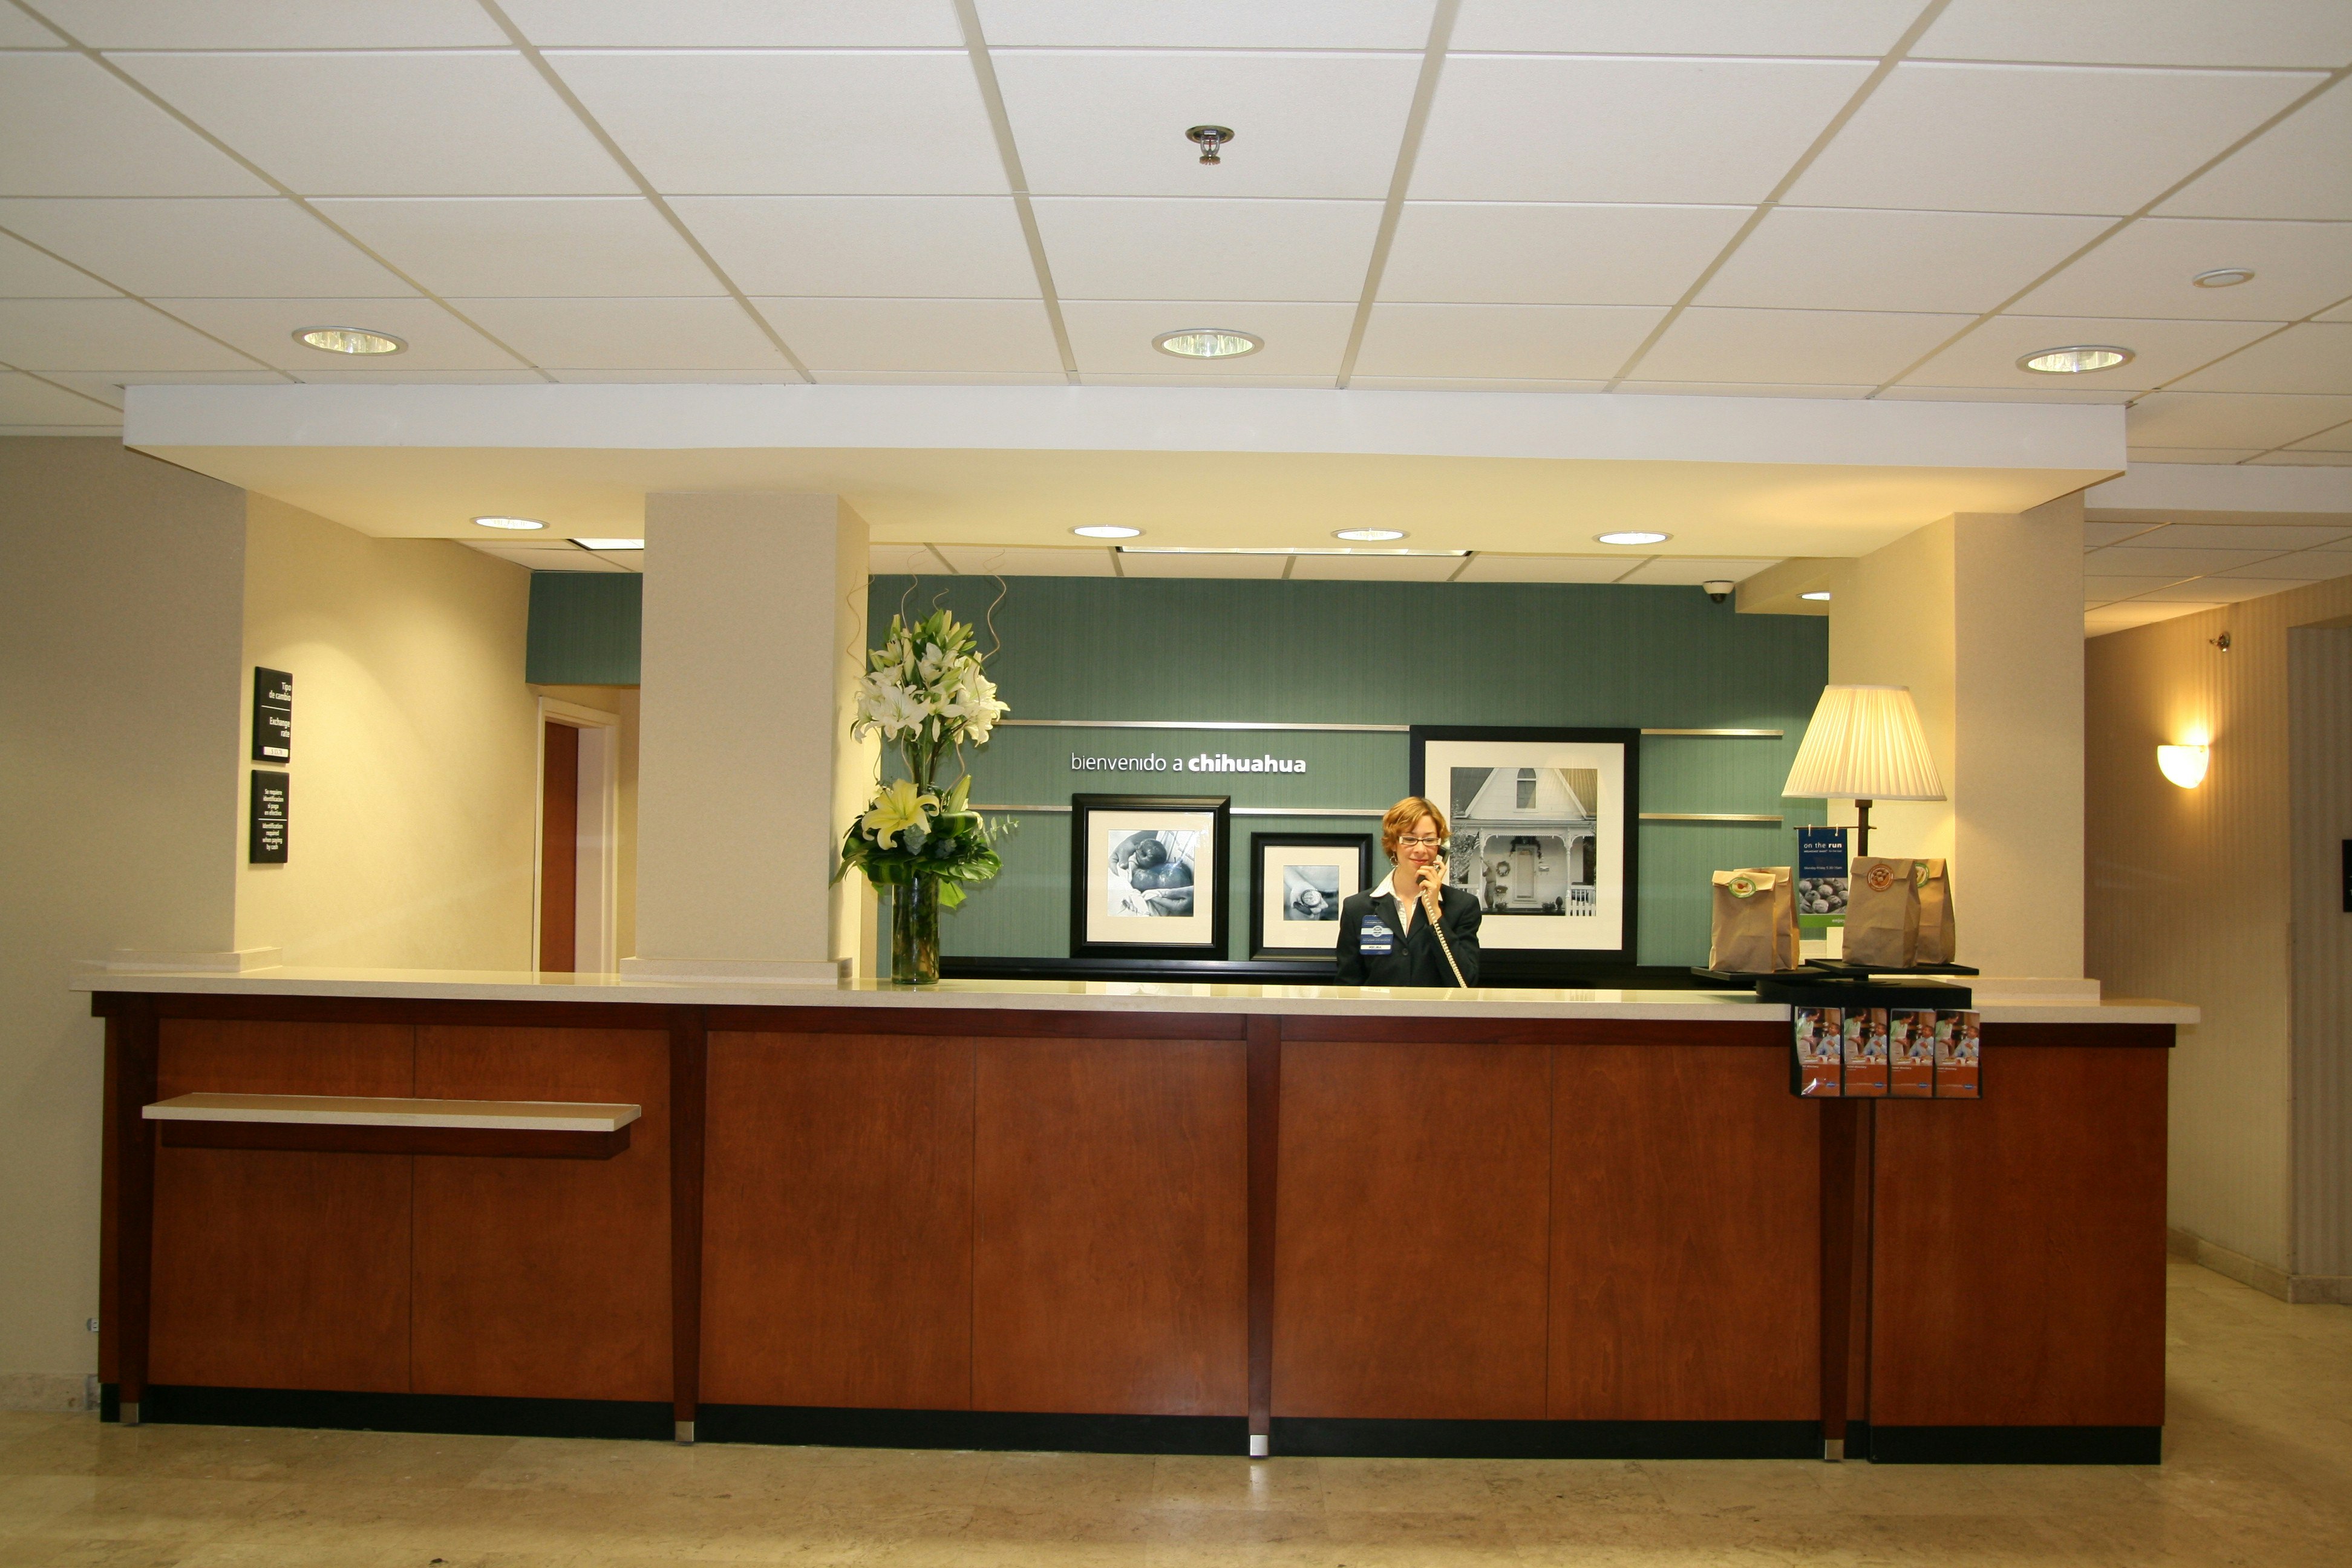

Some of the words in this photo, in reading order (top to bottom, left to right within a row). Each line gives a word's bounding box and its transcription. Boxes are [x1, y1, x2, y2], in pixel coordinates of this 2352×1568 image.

[281, 682, 292, 692] Tipo
[269, 690, 275, 699] de
[275, 693, 291, 702] cambio
[269, 716, 290, 729] Exchange
[281, 730, 290, 738] rate
[1071, 753, 1166, 771] bienvenido
[1172, 757, 1183, 772] a
[1188, 754, 1306, 773] chihuahua
